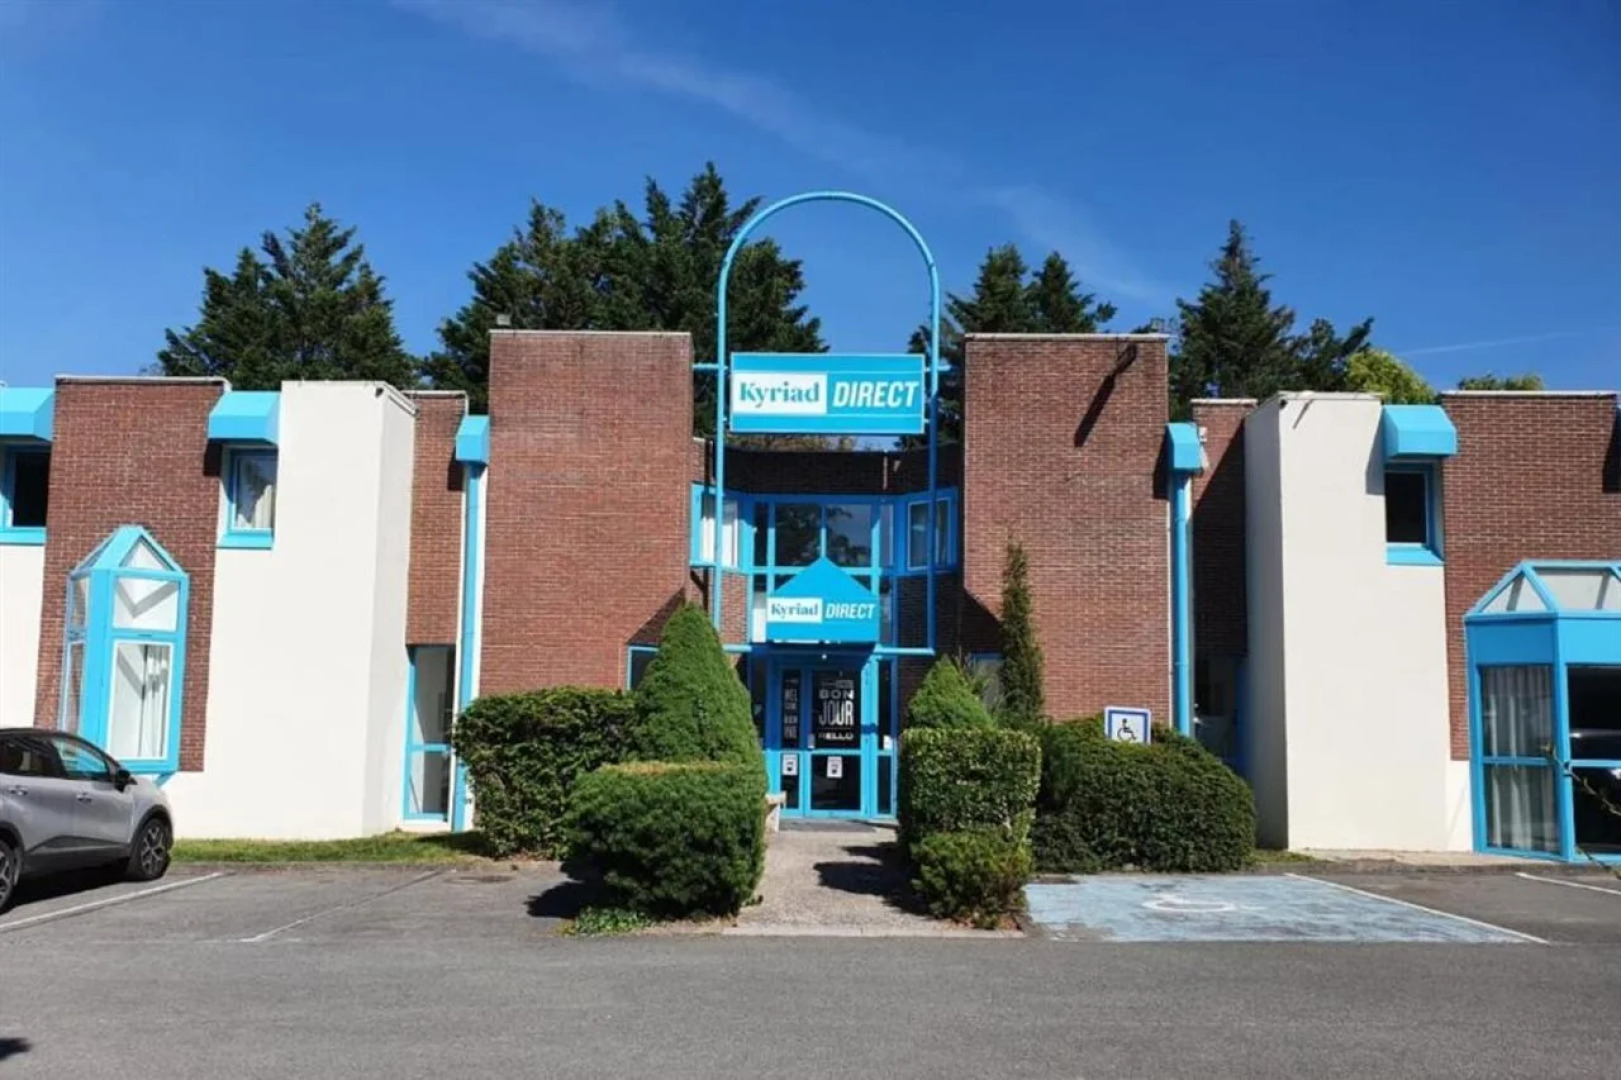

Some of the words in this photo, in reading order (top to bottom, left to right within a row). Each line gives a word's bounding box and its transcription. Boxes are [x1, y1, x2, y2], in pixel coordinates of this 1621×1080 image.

[740, 381, 820, 408] Kyriad
[832, 381, 920, 408] DIRECT
[771, 602, 818, 618] Kyriad
[825, 603, 876, 619] DIRECT
[818, 700, 854, 726] JOUR
